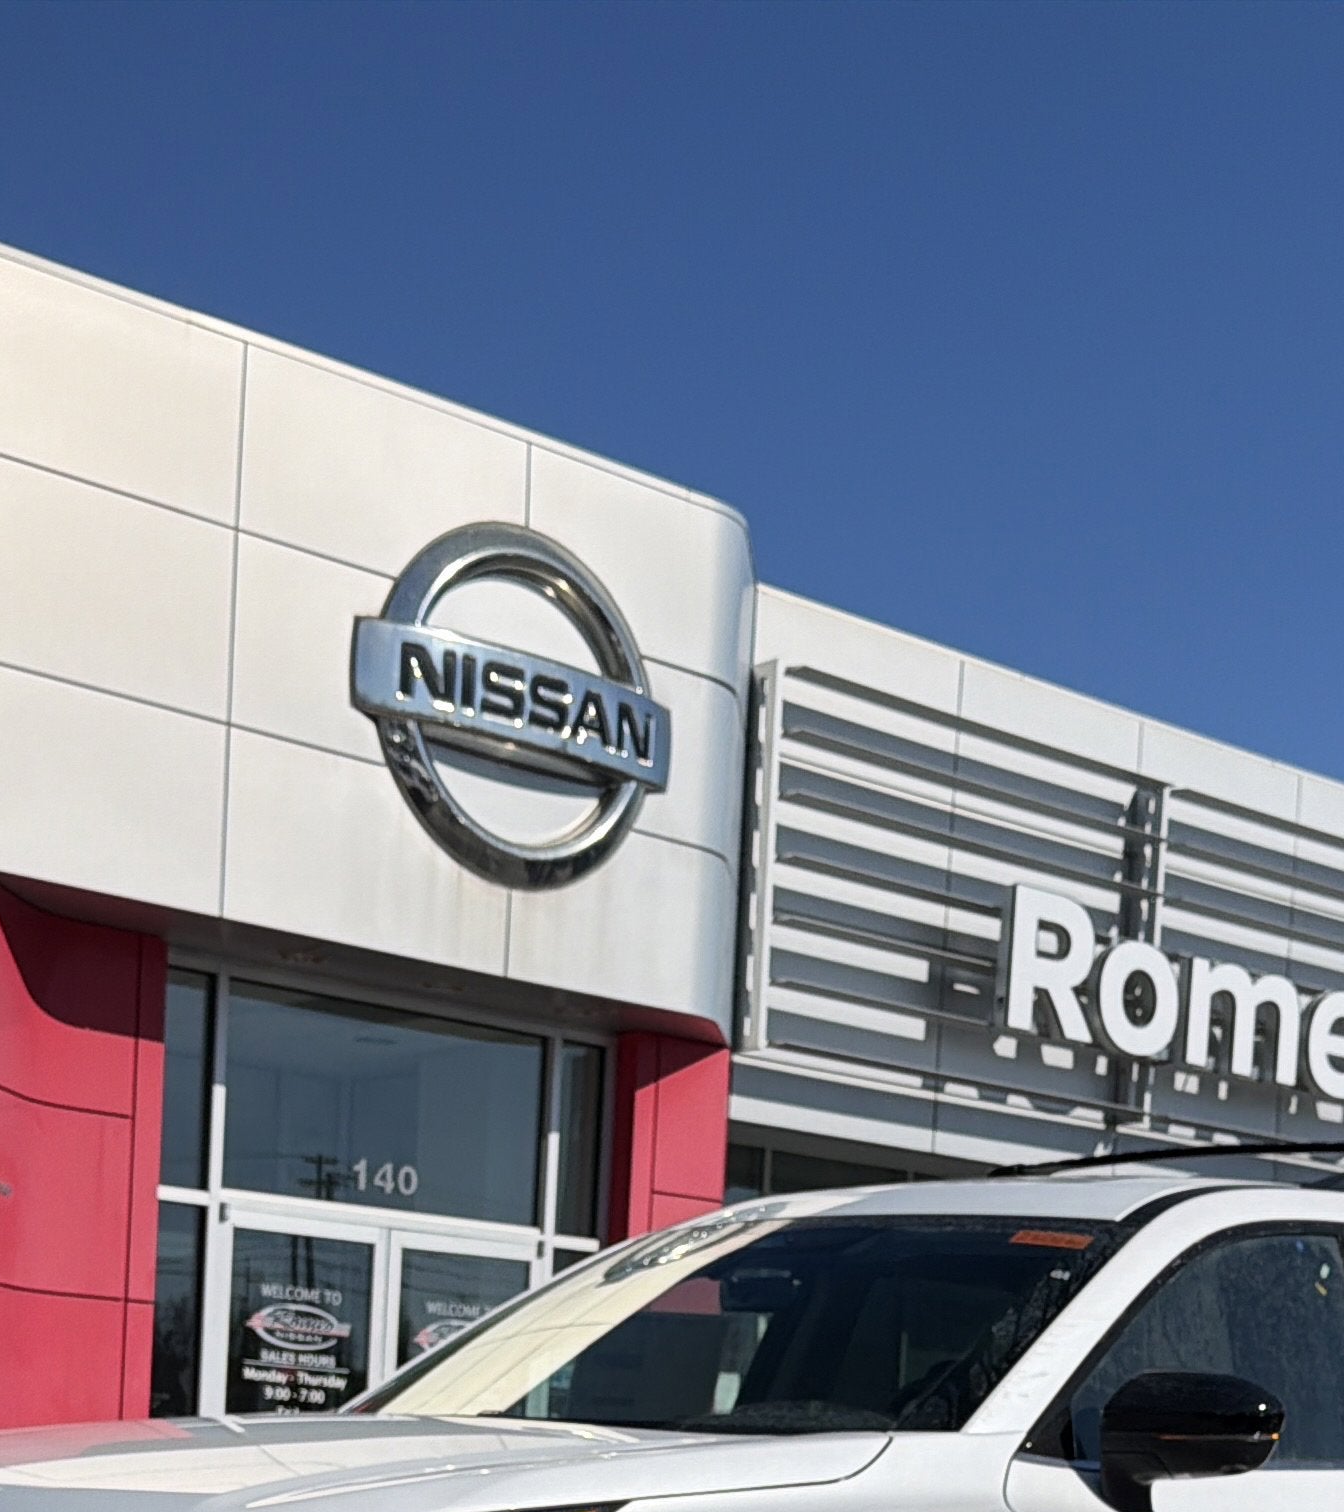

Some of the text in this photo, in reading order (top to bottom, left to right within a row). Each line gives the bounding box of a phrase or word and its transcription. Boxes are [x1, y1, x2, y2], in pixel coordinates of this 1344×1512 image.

[397, 641, 654, 768] NISSAN
[353, 1158, 419, 1196] 140
[261, 1282, 343, 1306] WELCOME TO
[424, 1301, 480, 1318] WELCOME
[260, 1347, 336, 1369] SALES HOURS
[242, 1366, 289, 1385] Monday
[296, 1371, 348, 1391] Thursday
